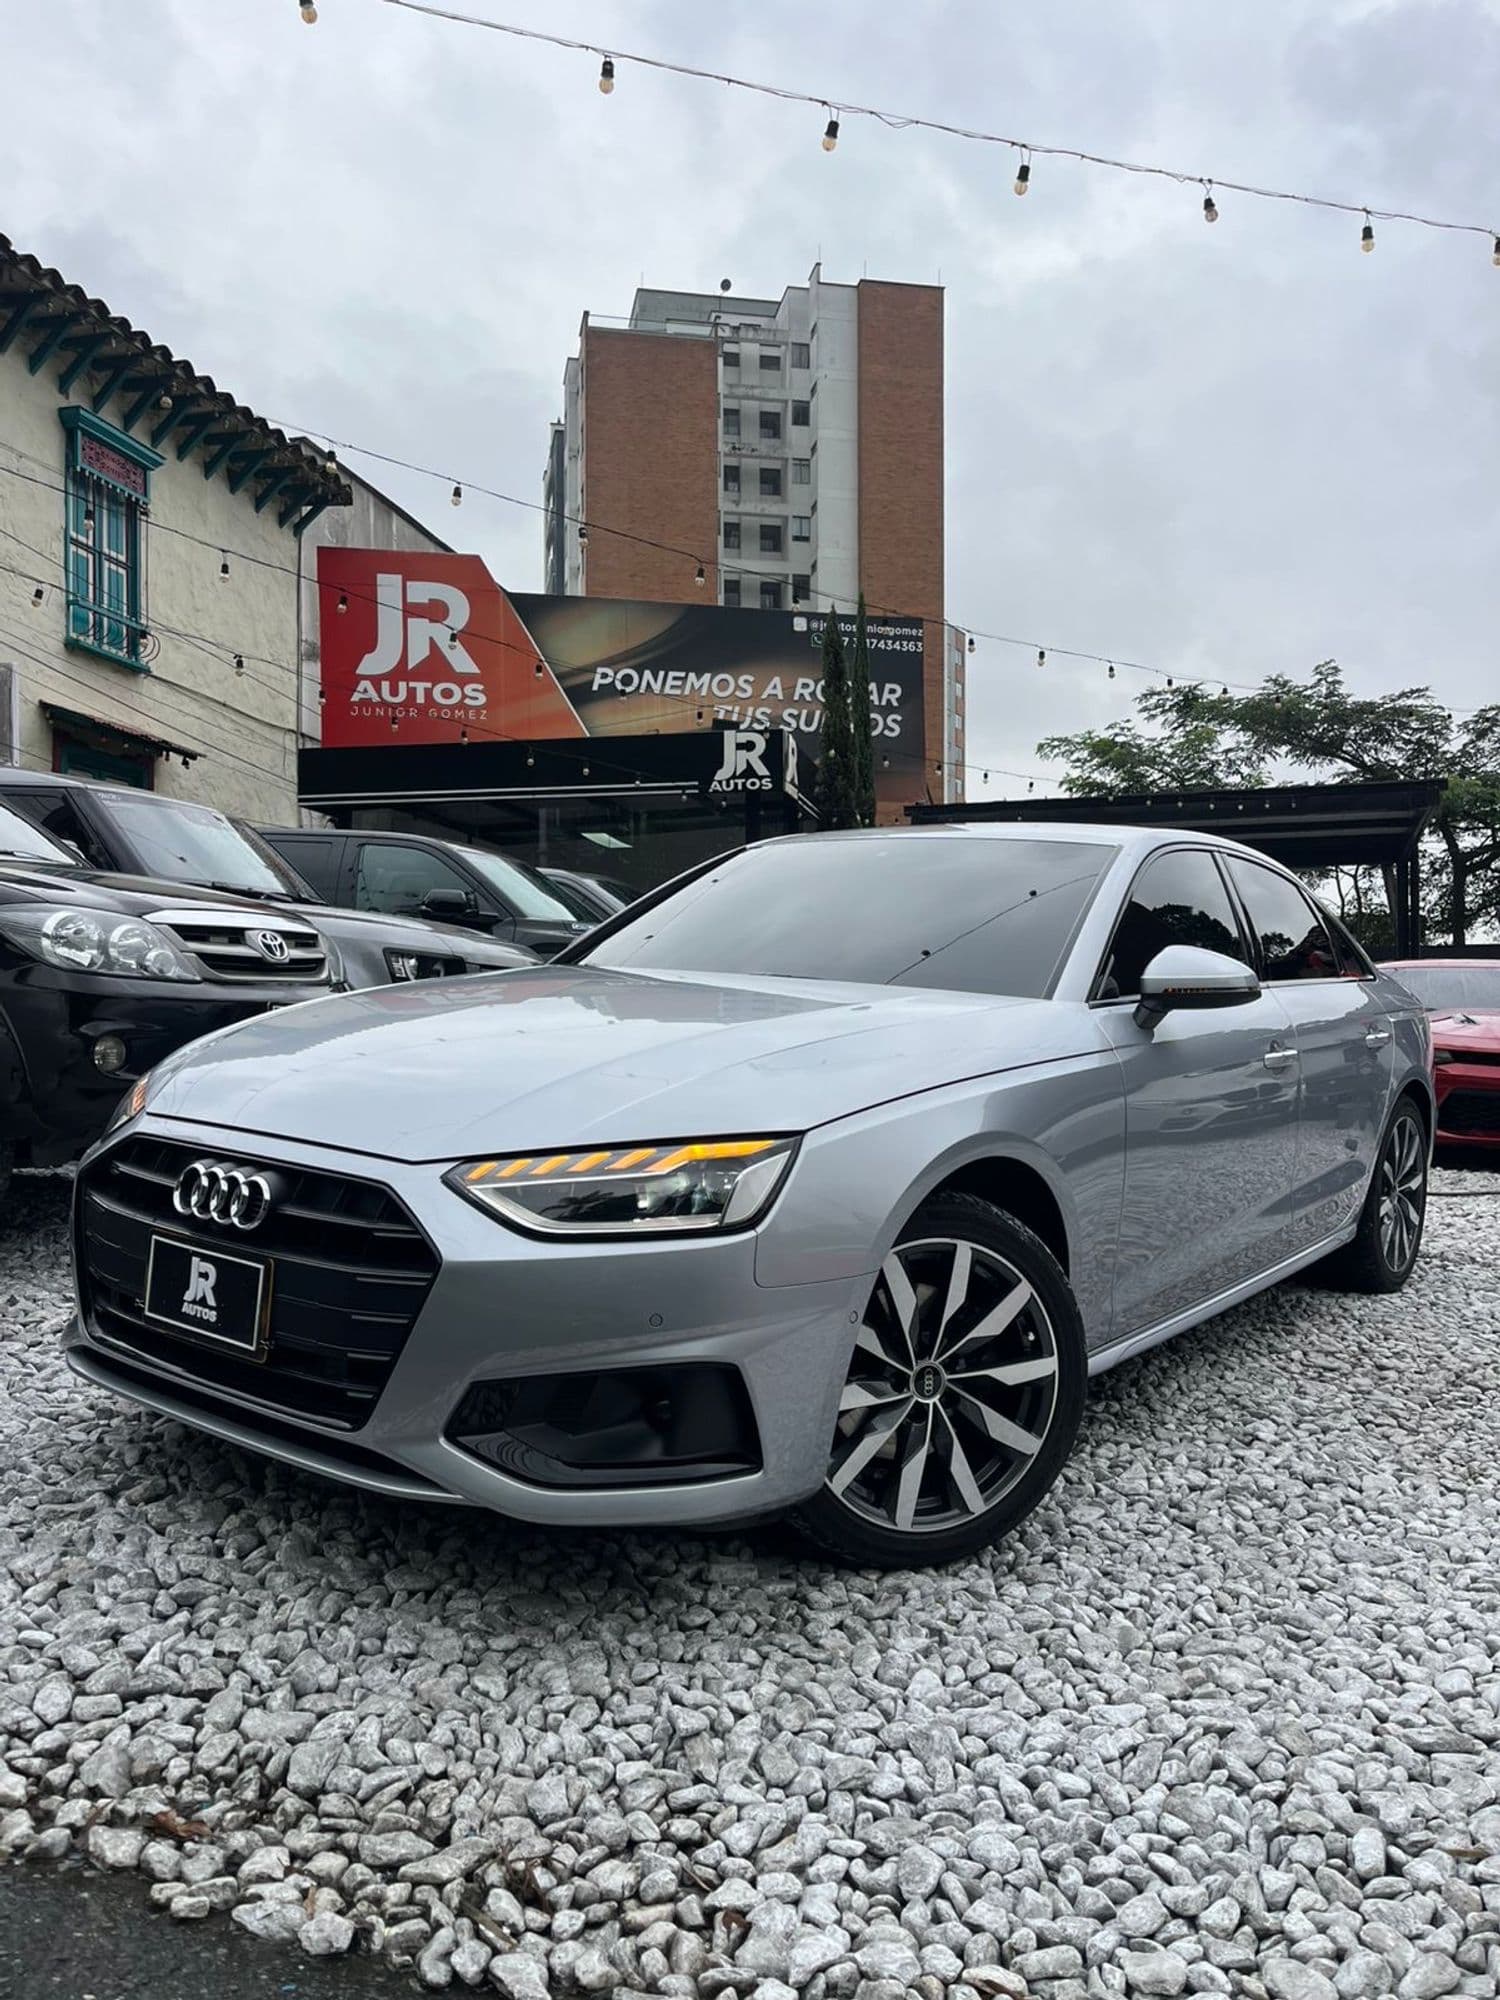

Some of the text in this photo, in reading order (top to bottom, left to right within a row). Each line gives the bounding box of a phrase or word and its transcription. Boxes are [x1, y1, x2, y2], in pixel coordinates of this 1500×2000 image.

[355, 573, 480, 675] JR
[350, 679, 487, 706] AUTOS
[591, 666, 903, 707] PONEMOS A RAR
[351, 706, 488, 720] JUNIOR GOMEZ
[714, 704, 903, 739] TUS SUOS
[714, 730, 771, 780] JR
[709, 778, 773, 792] AUTOS
[183, 1256, 217, 1307] JR
[181, 1302, 218, 1323] AUTOS
